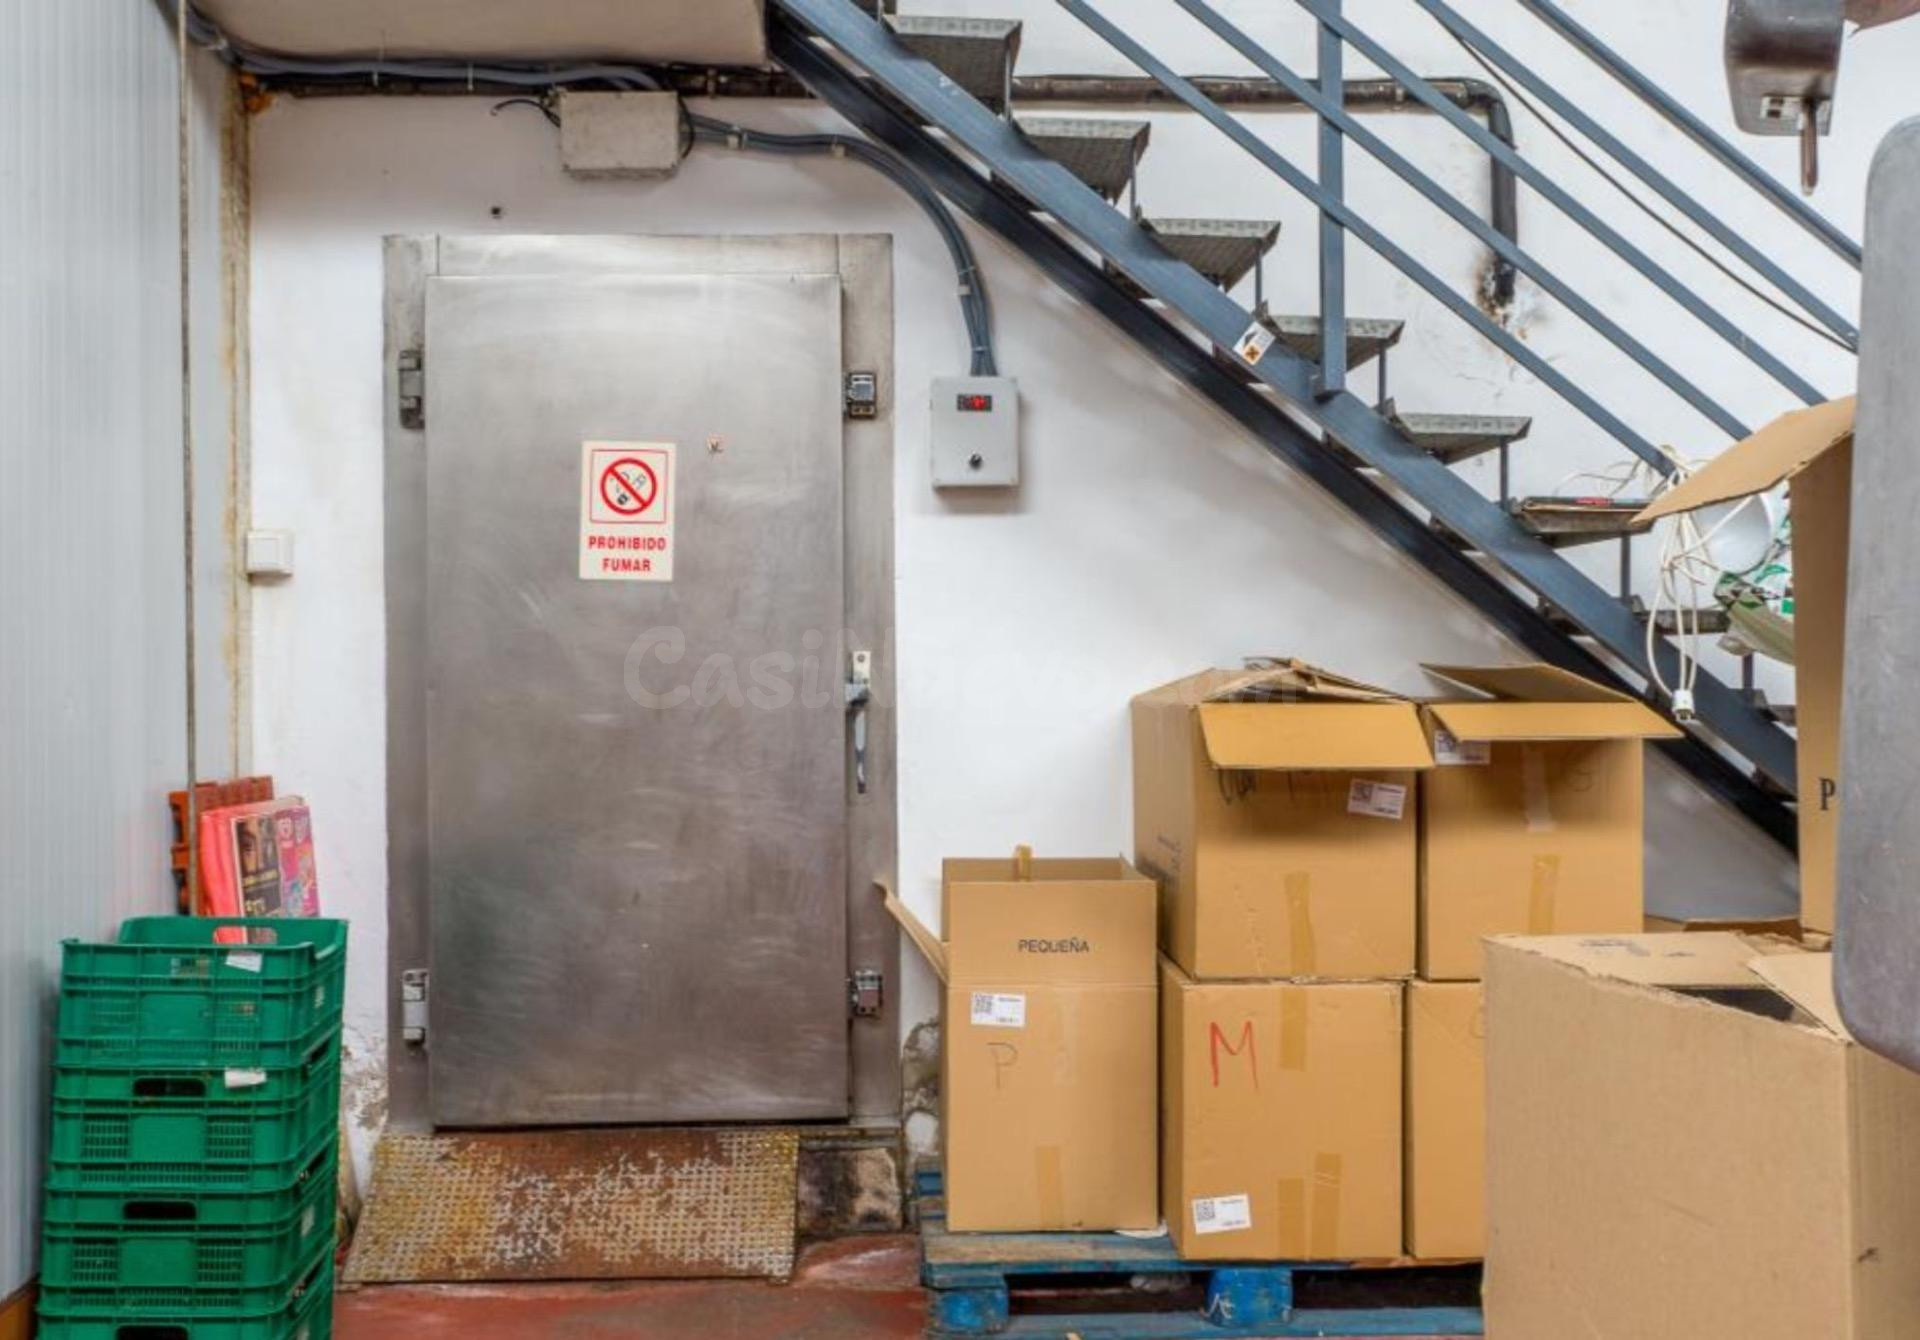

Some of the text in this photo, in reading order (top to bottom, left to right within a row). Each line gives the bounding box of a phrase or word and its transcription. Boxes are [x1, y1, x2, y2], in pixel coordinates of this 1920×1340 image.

[588, 536, 667, 550] PROHIBIDO
[602, 558, 651, 572] FUMAR
[1018, 936, 1090, 953] PEQUEÑA
[1210, 1021, 1259, 1089] M
